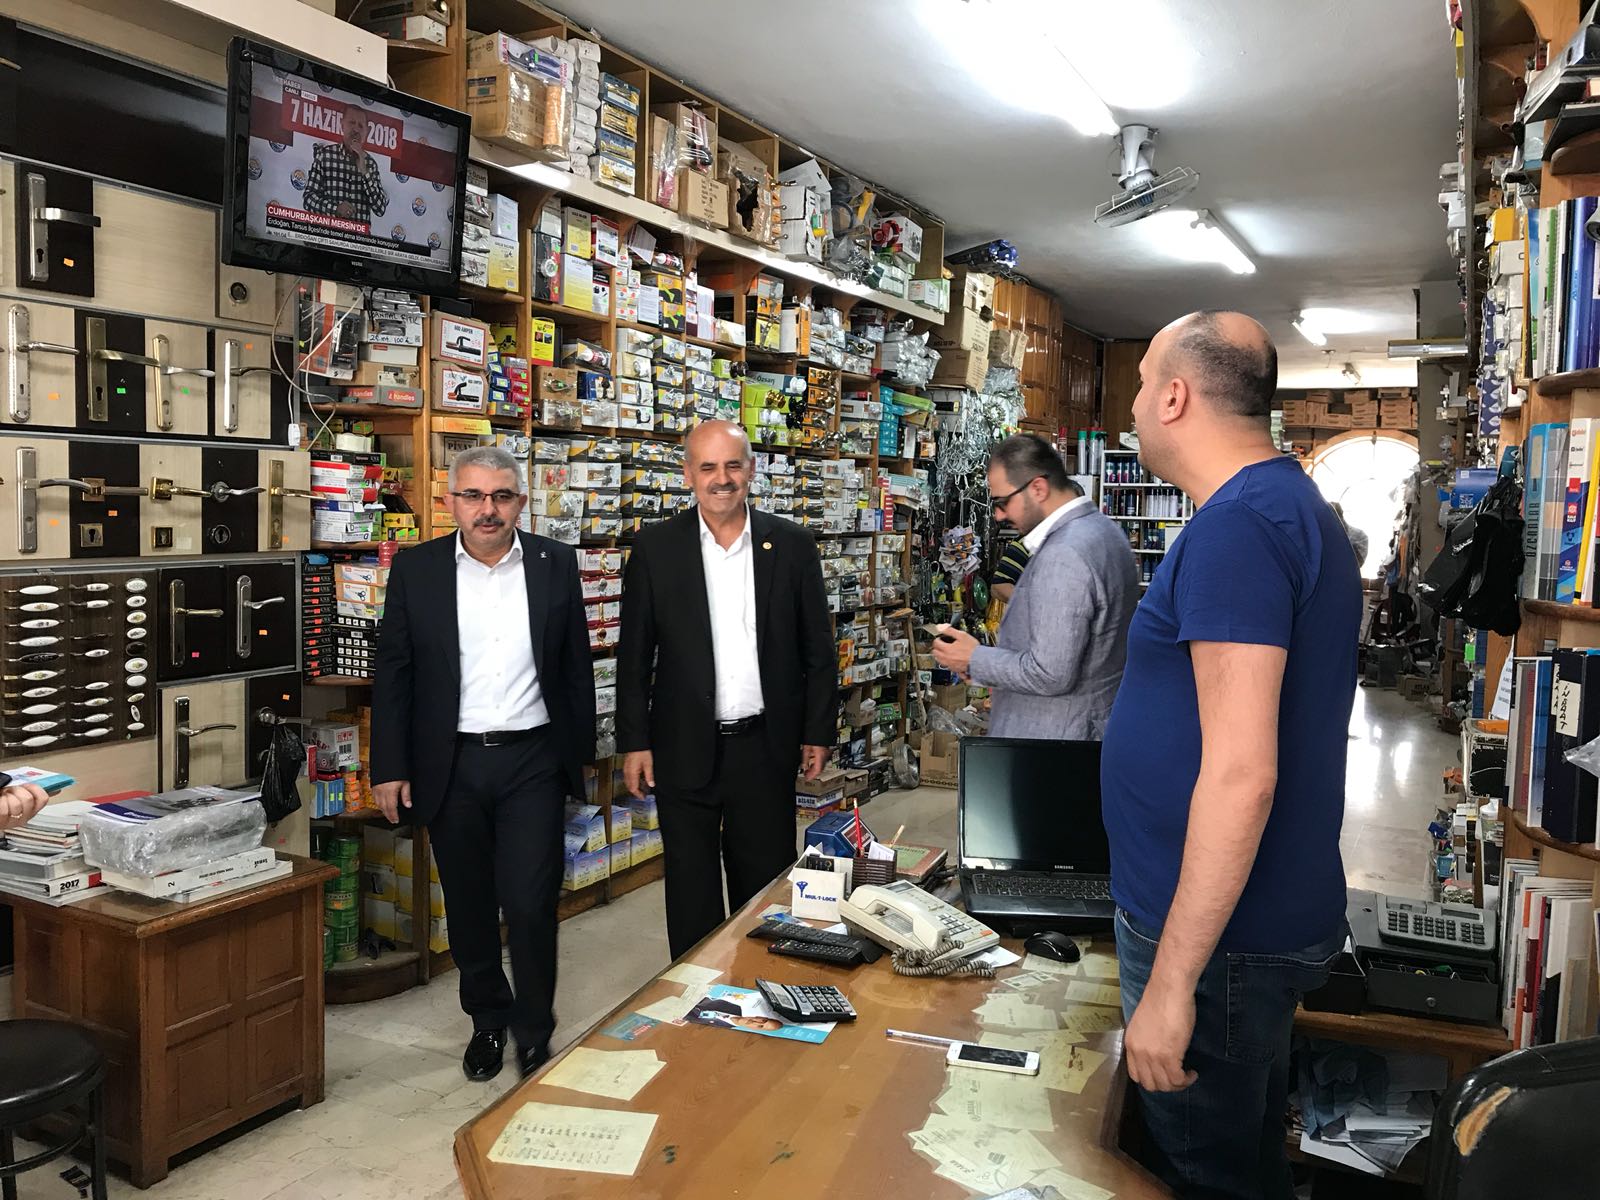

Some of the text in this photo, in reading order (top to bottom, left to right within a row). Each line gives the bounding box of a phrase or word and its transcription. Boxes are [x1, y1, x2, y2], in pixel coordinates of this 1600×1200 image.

[291, 99, 300, 123] 7
[367, 121, 398, 150] 2018
[268, 206, 366, 233] CUMHURBAŞKANI MERSİN'DE
[268, 218, 290, 228] Erdoğan,
[59, 878, 80, 891] 2017
[804, 893, 837, 903] MUL-T-LOCK
